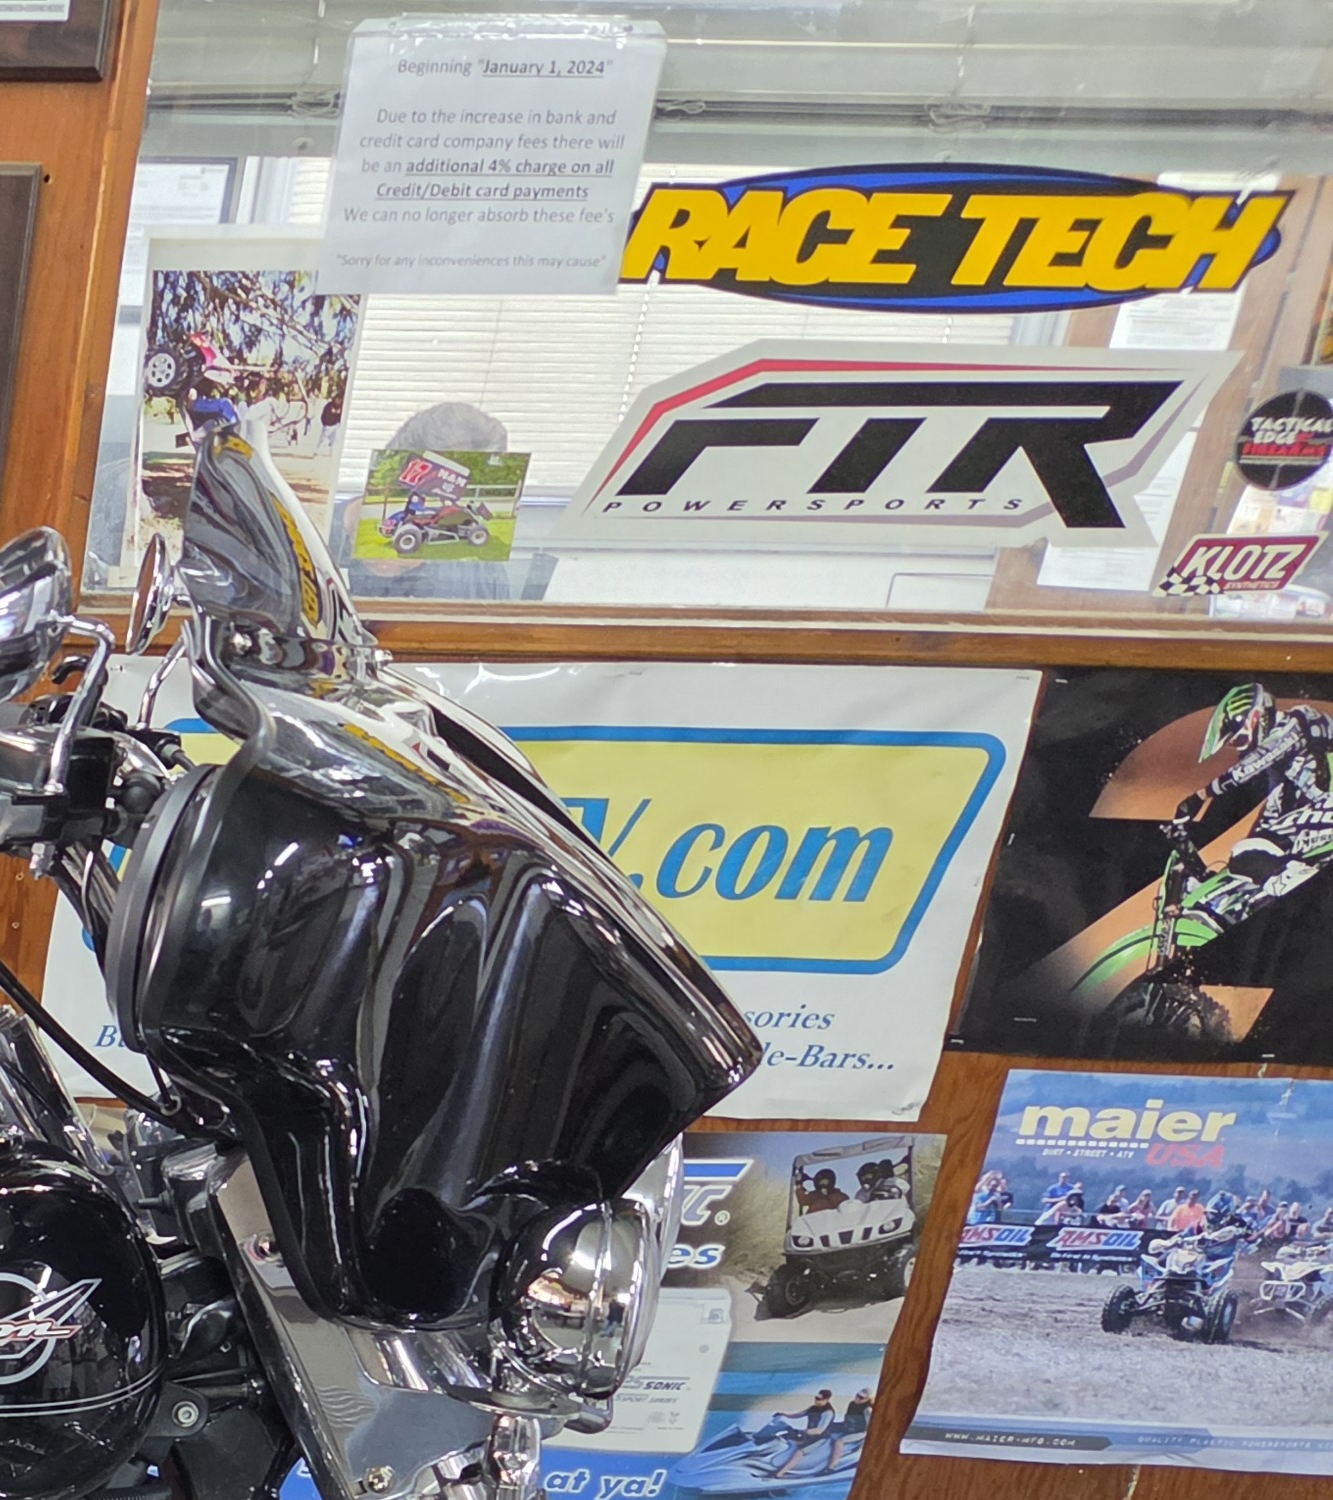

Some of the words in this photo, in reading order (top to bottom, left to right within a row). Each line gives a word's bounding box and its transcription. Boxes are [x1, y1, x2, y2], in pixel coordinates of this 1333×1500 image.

[398, 59, 472, 76] Beginning
[548, 60, 562, 76] 1,
[376, 108, 407, 124] Due
[412, 110, 427, 124] to
[432, 108, 457, 124] the
[460, 109, 523, 125] increase
[528, 110, 541, 125] in
[546, 109, 582, 125] bank
[587, 110, 617, 125] and
[359, 134, 402, 148] credit
[407, 134, 440, 148] card
[443, 137, 513, 151] company
[517, 133, 548, 150] fees
[553, 134, 593, 149] there
[598, 135, 625, 149] will
[361, 158, 379, 172] be
[384, 161, 402, 172] an
[406, 158, 484, 173] additional
[488, 159, 512, 173] 4%
[516, 158, 567, 175] charge
[572, 161, 591, 174] on
[596, 159, 614, 174] all
[376, 182, 472, 199] Credit/Debit
[475, 183, 509, 198] card
[513, 186, 589, 200] payments
[344, 207, 368, 221] We
[372, 210, 398, 222] can
[402, 211, 421, 222] no
[425, 207, 474, 225] longer
[477, 207, 529, 222] absorb
[533, 208, 575, 222] these
[578, 208, 614, 223] fee's
[619, 188, 953, 285] RACE
[951, 192, 1291, 291] TECH
[375, 254, 392, 267] for
[394, 257, 414, 268] any
[418, 254, 509, 267] inconveniences
[513, 254, 535, 267] this
[538, 257, 562, 268] may
[603, 497, 1025, 515] POWERSPORTS
[1181, 544, 1308, 580] KLOTZ
[559, 797, 895, 902] V.com
[743, 1003, 836, 1031] sories
[1019, 1099, 1237, 1142] maier
[1145, 1144, 1226, 1168] USA
[1054, 1229, 1140, 1247] AMSOIL
[643, 1381, 687, 1391] SONIC
[544, 1467, 589, 1494] at
[595, 1469, 667, 1500] ya!
